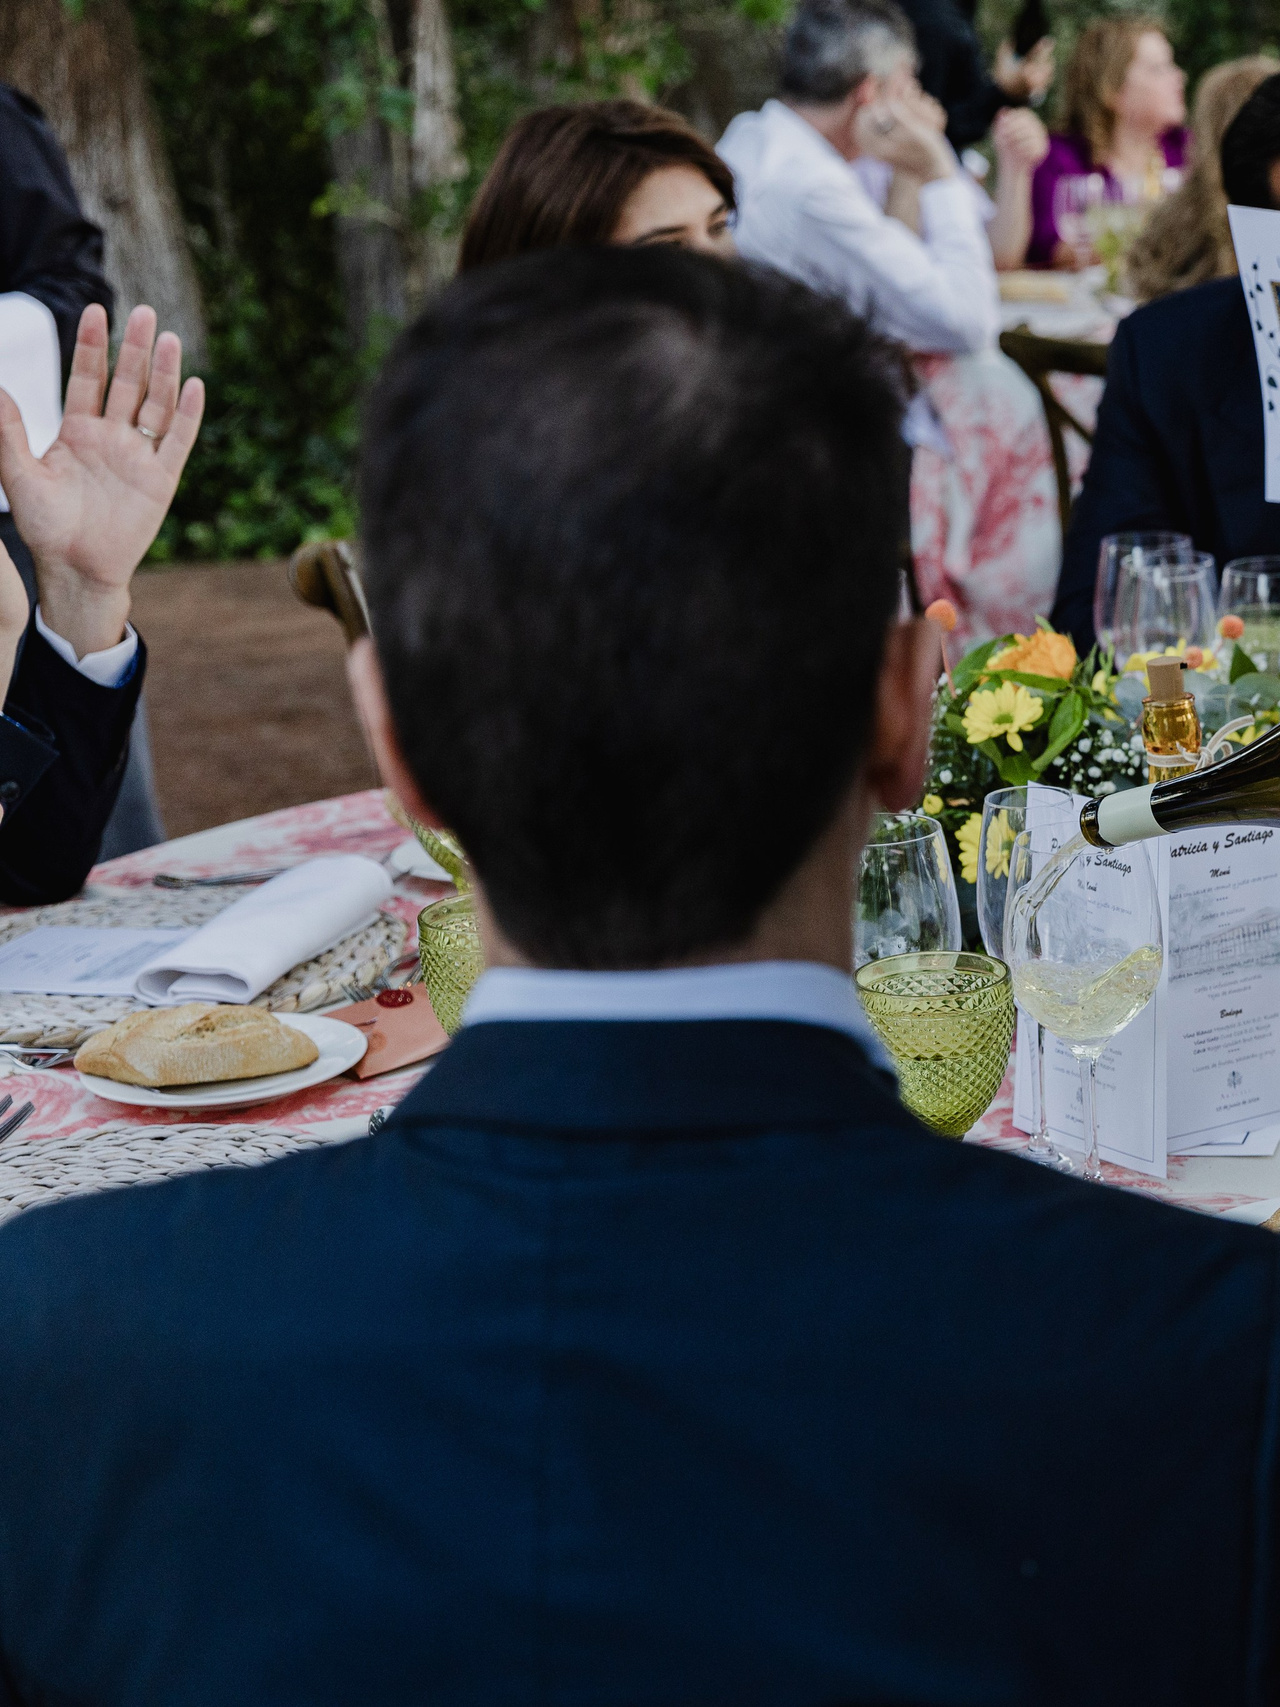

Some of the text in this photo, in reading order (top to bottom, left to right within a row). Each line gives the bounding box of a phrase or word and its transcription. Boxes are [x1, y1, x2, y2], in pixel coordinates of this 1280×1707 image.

[1169, 829, 1274, 858] atricia y Santiago
[1094, 852, 1132, 877] Santiago
[1209, 865, 1231, 879] Menú
